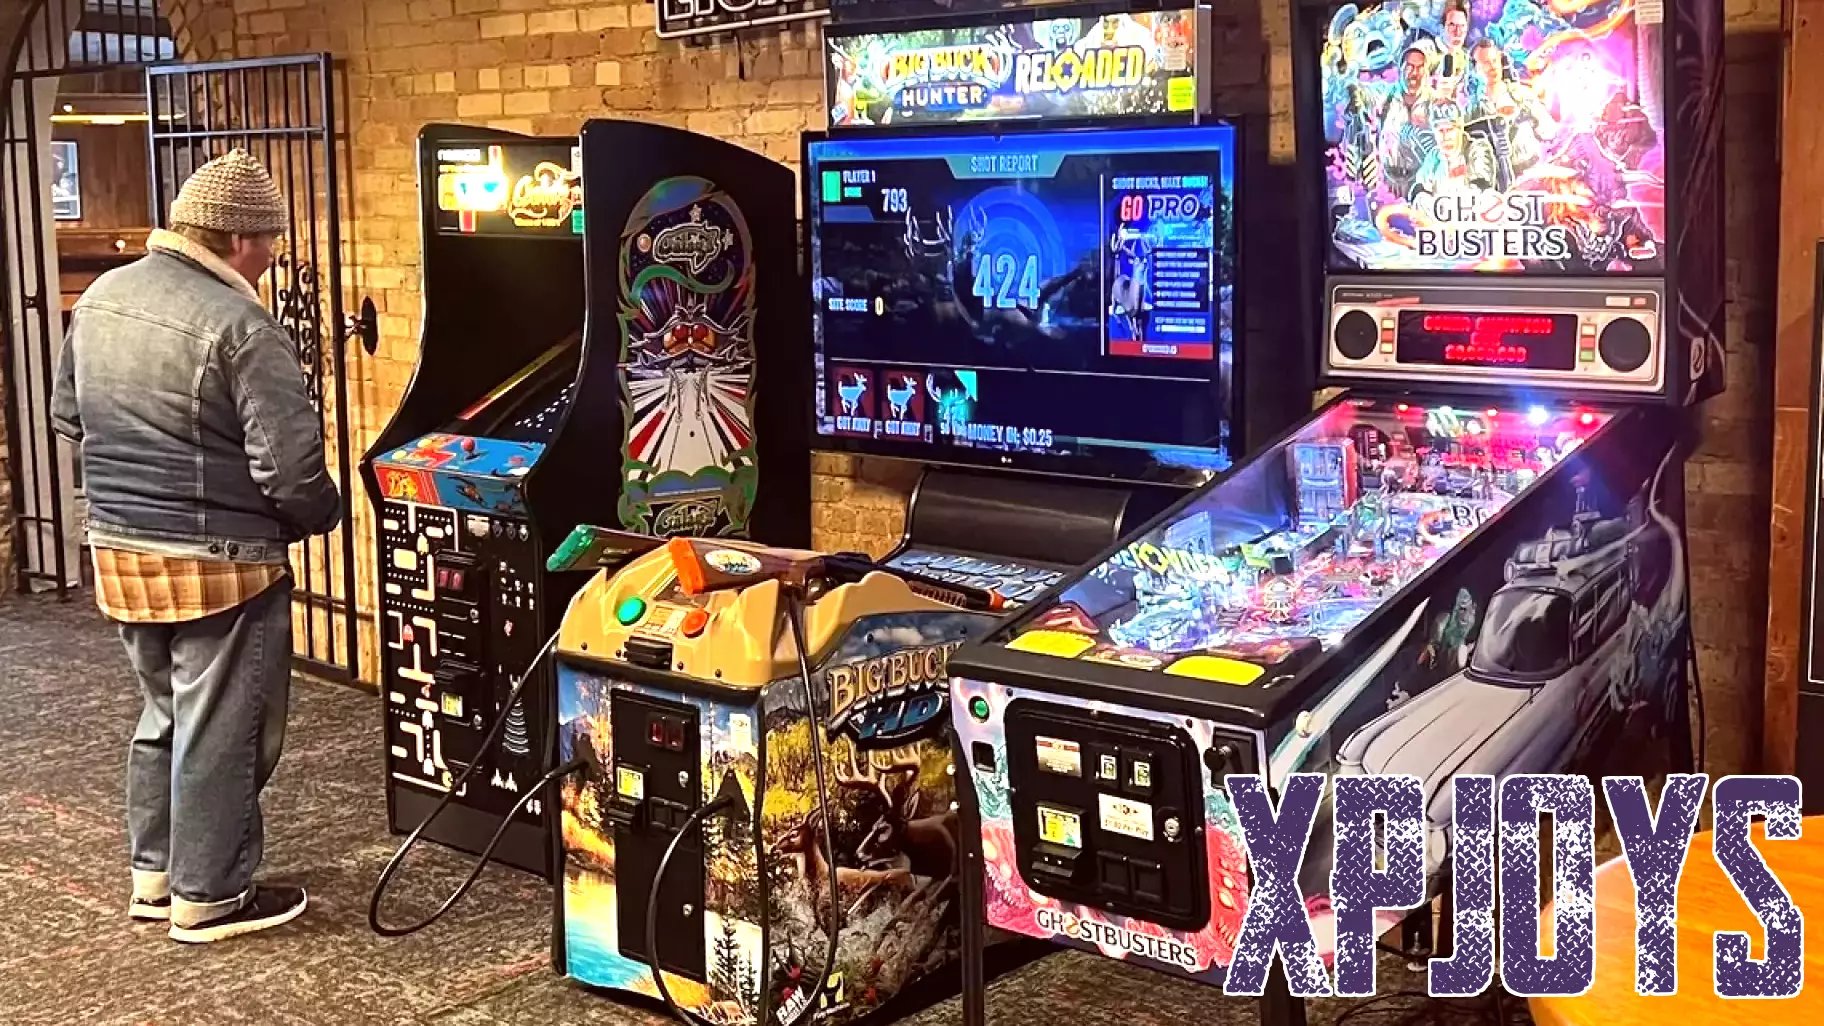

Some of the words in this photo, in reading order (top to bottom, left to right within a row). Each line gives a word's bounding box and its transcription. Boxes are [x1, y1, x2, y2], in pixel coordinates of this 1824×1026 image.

[902, 86, 982, 106] HUNTER
[970, 155, 997, 172] SHOT
[1000, 154, 1038, 172] REPORT
[881, 188, 907, 213] 793
[1121, 195, 1143, 221] GO
[1147, 194, 1200, 221] PRO
[1434, 195, 1545, 222] GHOST
[973, 254, 1041, 309] 424
[968, 424, 1004, 442] MONEY
[1023, 427, 1053, 447] $0.25
[829, 660, 881, 719] BIG
[1037, 910, 1196, 966] GHOSTBUSTERS
